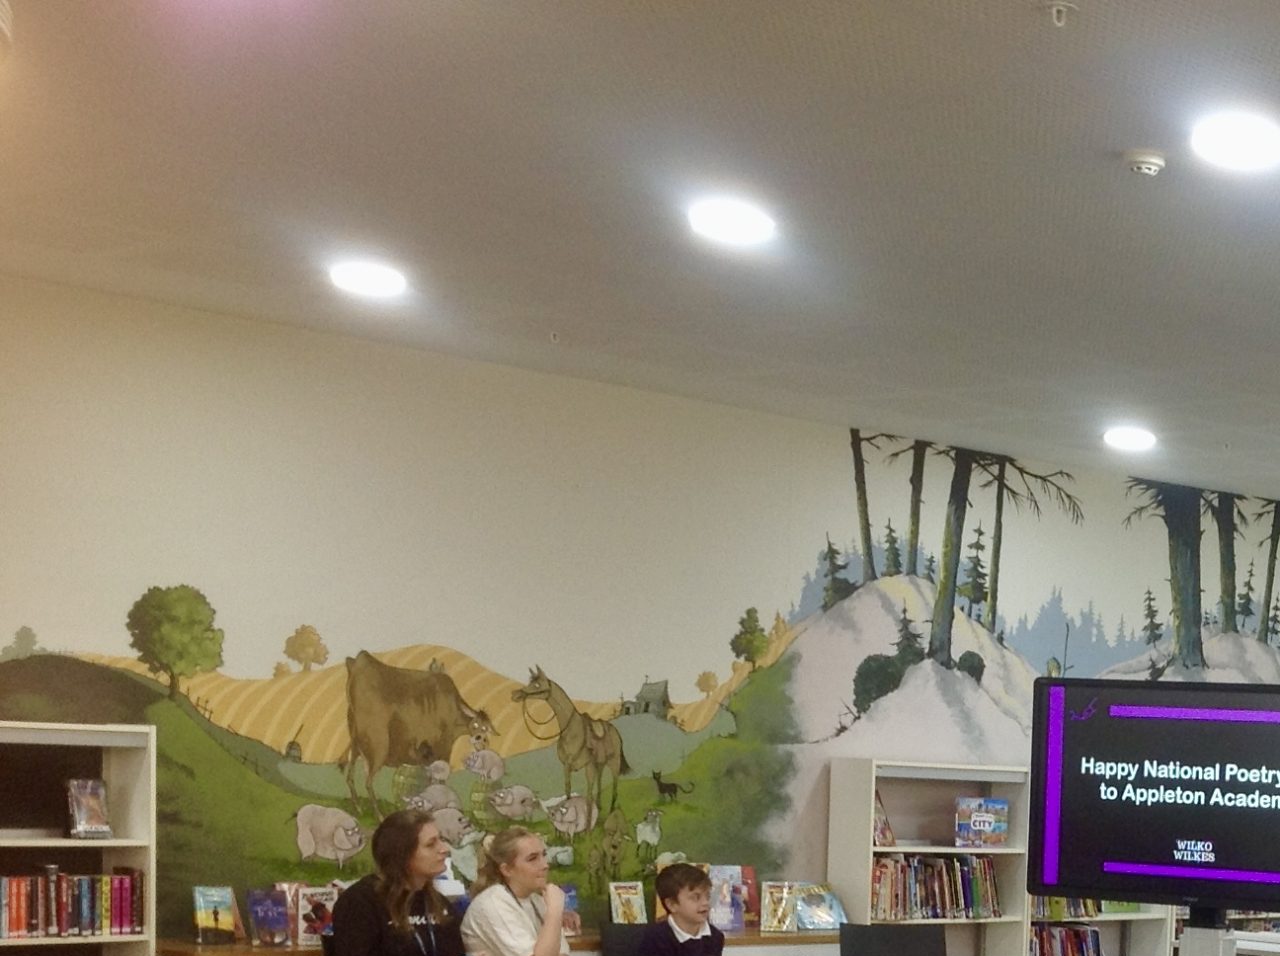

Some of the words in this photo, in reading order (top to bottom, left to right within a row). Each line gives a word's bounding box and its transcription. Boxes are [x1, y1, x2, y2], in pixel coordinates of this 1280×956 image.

[1081, 757, 1138, 780] Happy
[1143, 760, 1220, 782] National
[1099, 782, 1118, 800] to
[1122, 785, 1205, 806] Appleton
[972, 820, 993, 828] CITY
[1176, 839, 1213, 851] WILKO
[1173, 850, 1215, 862] WILKES
